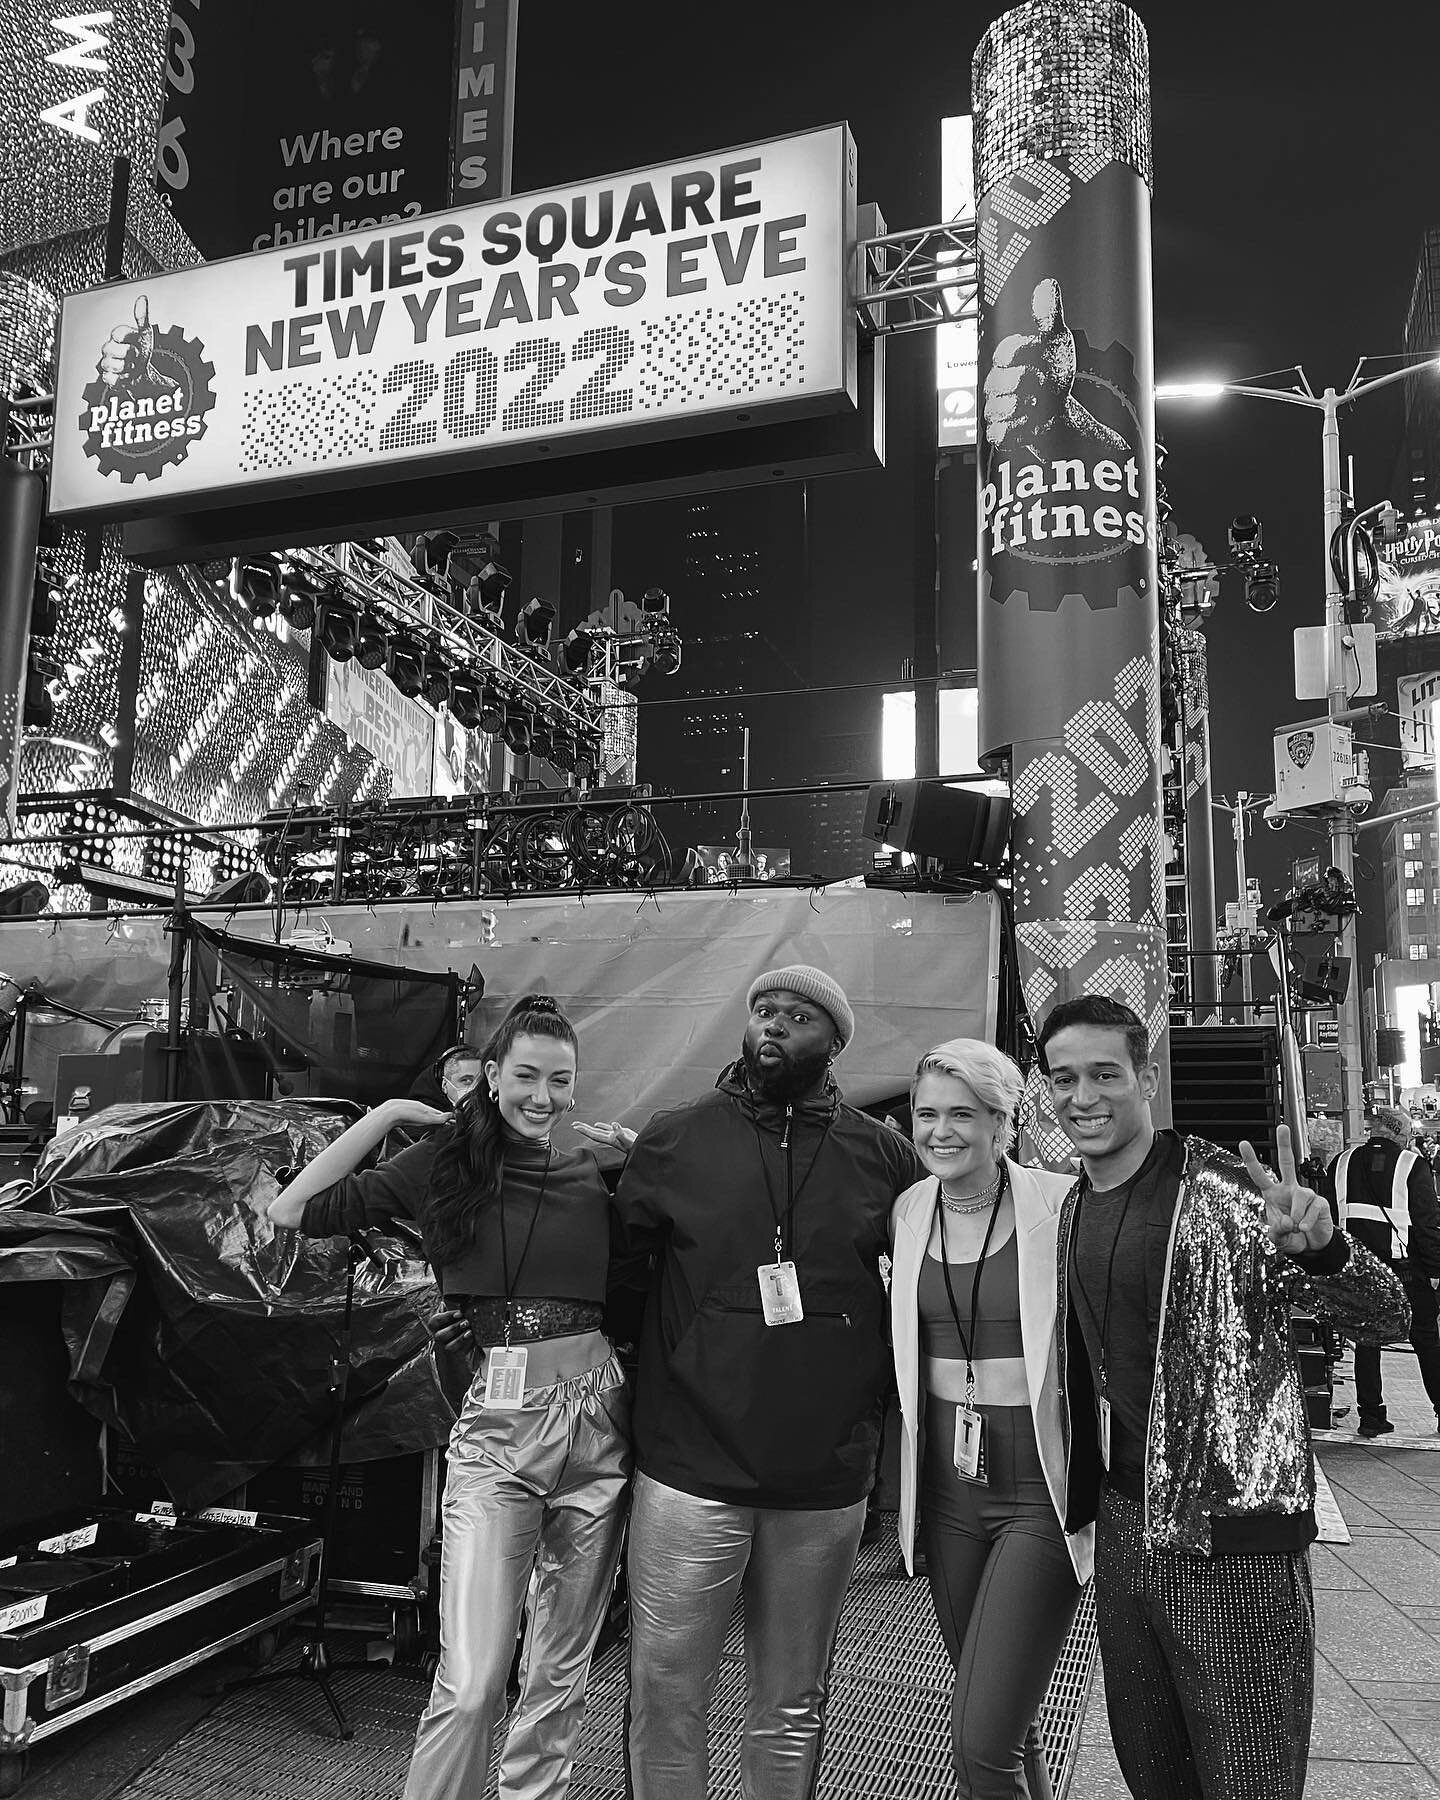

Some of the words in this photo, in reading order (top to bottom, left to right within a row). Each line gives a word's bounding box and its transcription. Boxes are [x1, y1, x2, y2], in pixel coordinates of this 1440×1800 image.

[457, 0, 495, 189] IMES
[280, 126, 403, 168] Where
[272, 180, 333, 211] are
[342, 168, 405, 200] our
[283, 223, 465, 308] TIMES
[481, 157, 761, 265] SQUARE
[245, 300, 386, 376] NEW
[402, 249, 647, 344] YEAR'S
[666, 214, 807, 297] EVE
[89, 386, 184, 432] planet
[378, 325, 635, 451] 2022
[100, 414, 201, 448] fitness
[979, 456, 1140, 533] planet
[1382, 536, 1424, 563] Harry
[1411, 676, 1440, 706] LIT
[363, 689, 400, 745] BEST
[962, 1419, 973, 1444] T
[302, 1481, 364, 1497] MARAND
[303, 1493, 362, 1510] SOND
